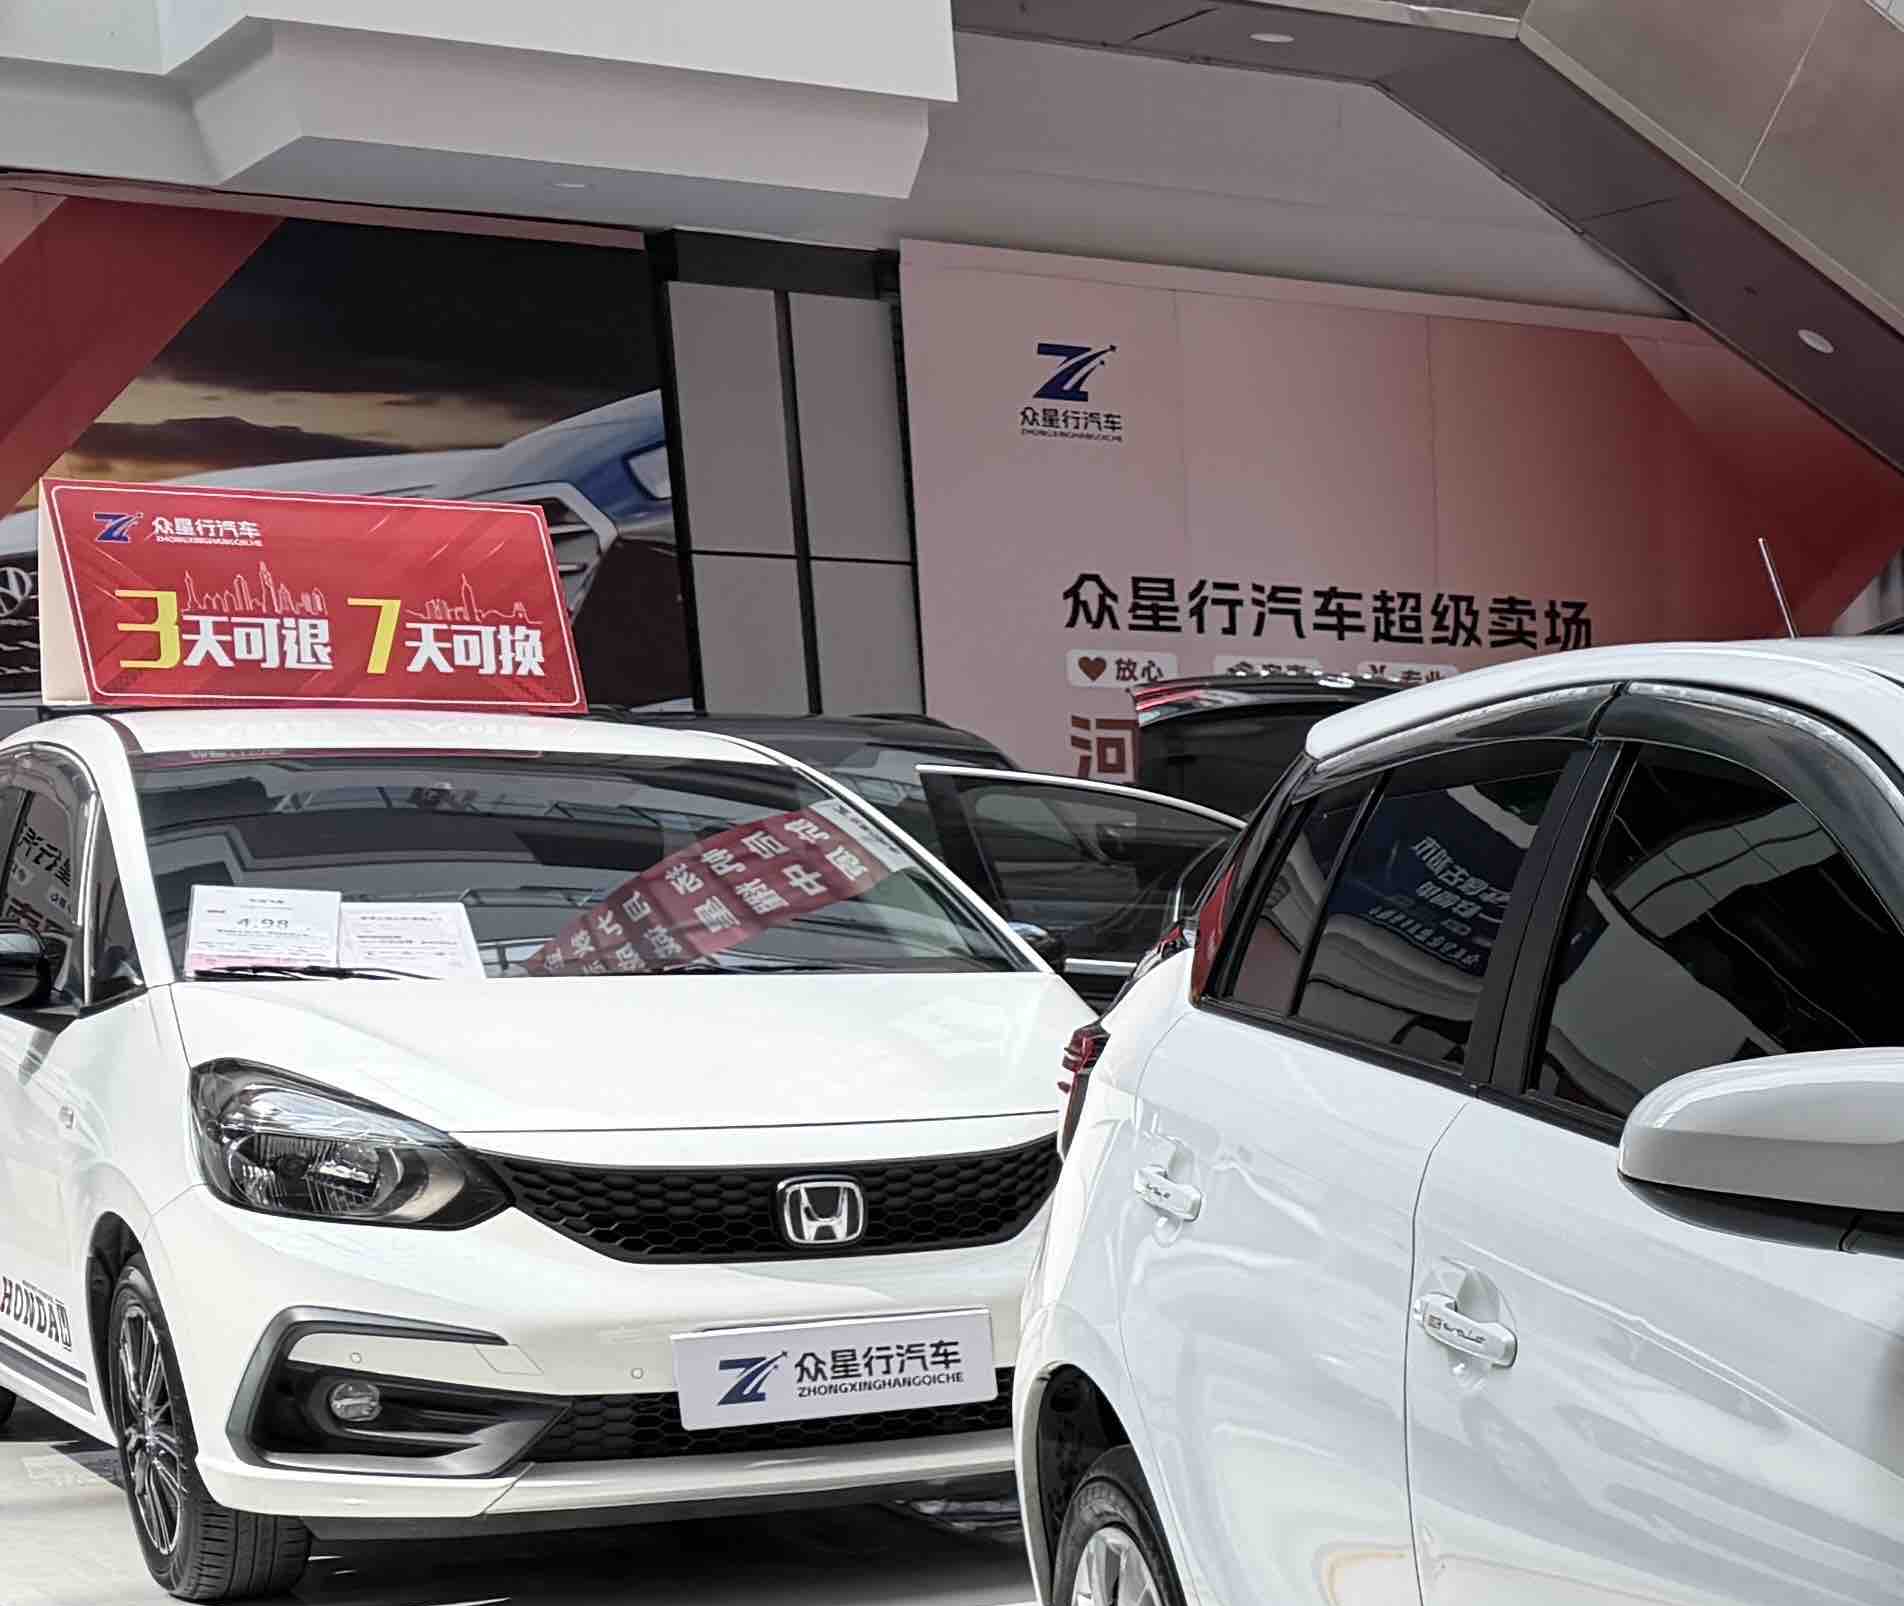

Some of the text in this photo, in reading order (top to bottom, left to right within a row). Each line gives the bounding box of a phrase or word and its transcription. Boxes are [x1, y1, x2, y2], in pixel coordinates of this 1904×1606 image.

[1020, 406, 1123, 431] 众星行汽车
[151, 516, 262, 538] 众星行汽车
[1062, 573, 1593, 652] 众星行汽车超级卖场
[114, 588, 545, 677] 3天可退 7天可换
[1115, 657, 1166, 684] 放心
[794, 1340, 963, 1383] 众星行汽车
